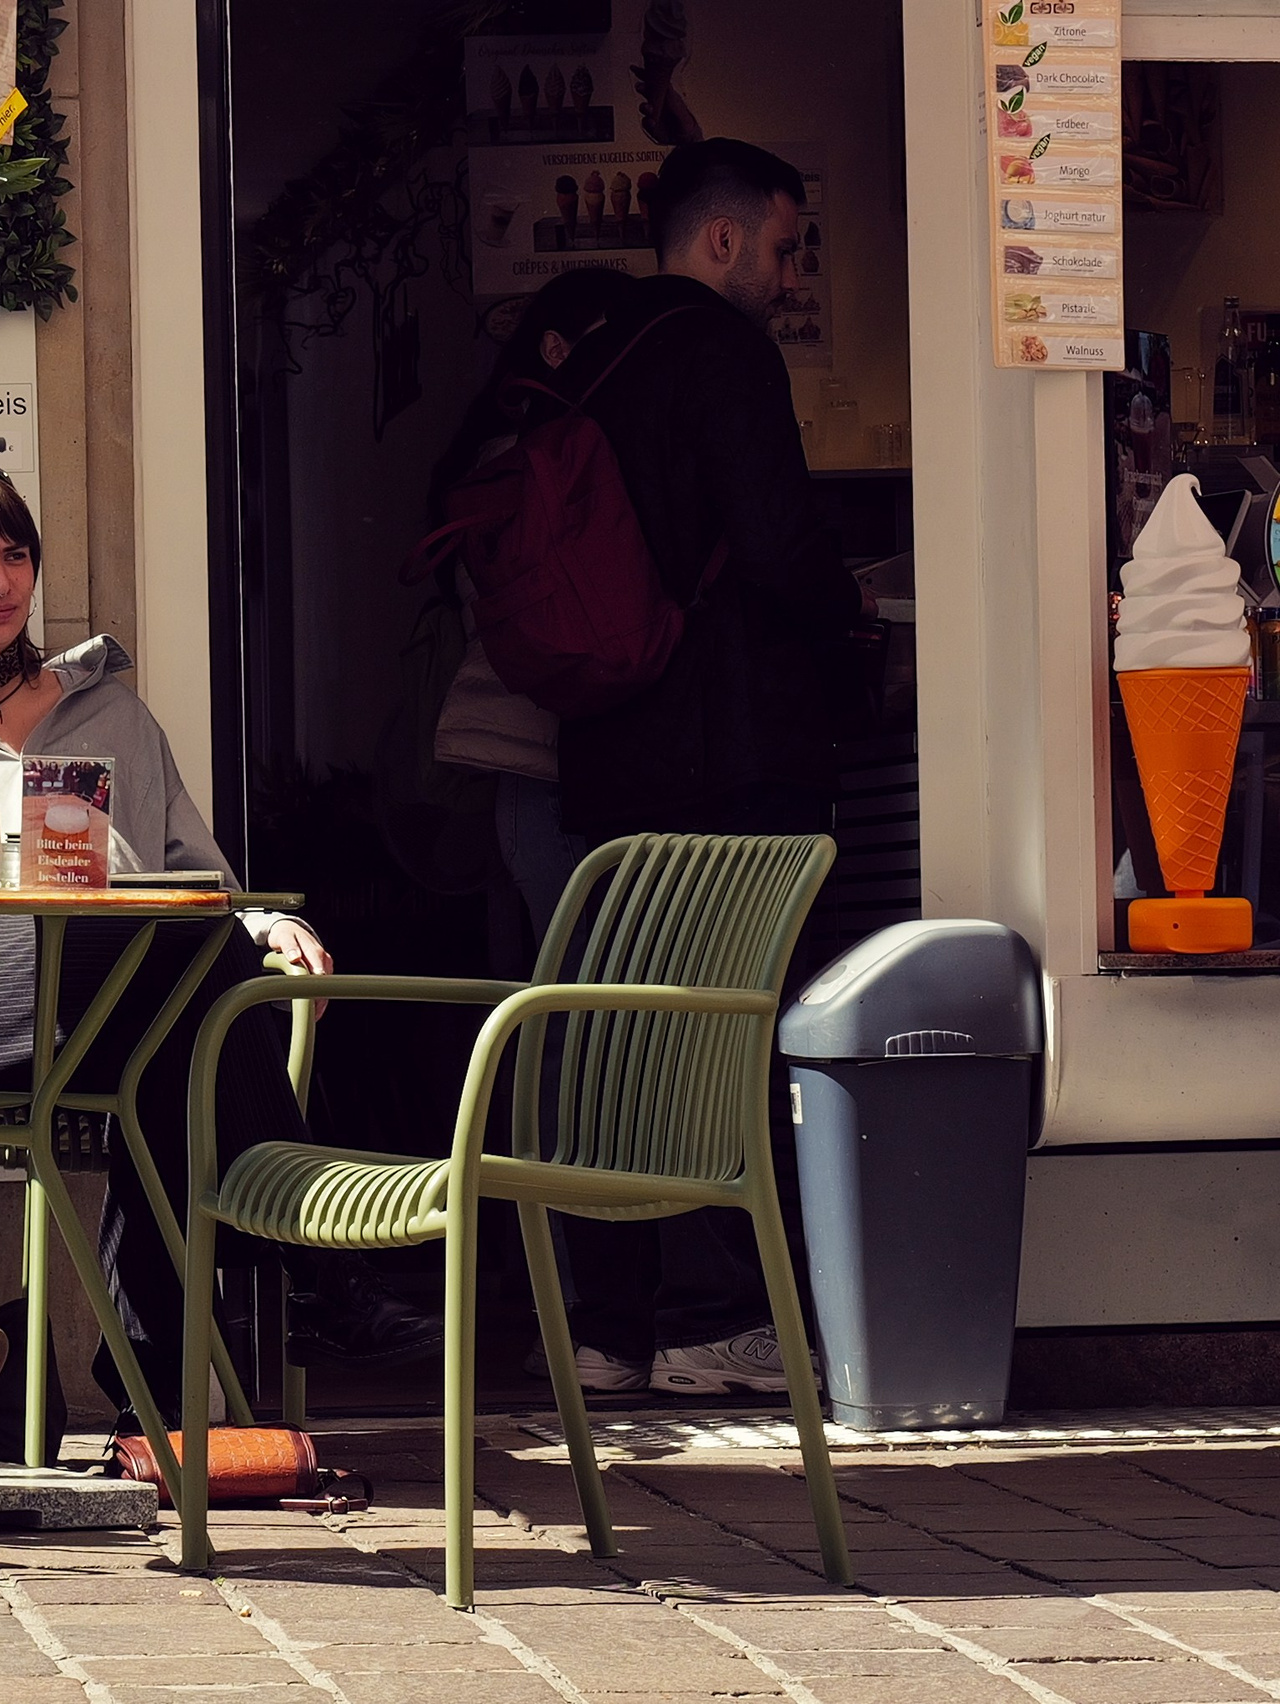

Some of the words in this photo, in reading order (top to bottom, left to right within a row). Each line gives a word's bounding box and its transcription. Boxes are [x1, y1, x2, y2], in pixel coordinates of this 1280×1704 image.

[1054, 27, 1087, 37] Zitrone
[1024, 45, 1045, 66] vegan
[1037, 73, 1058, 83] Dark
[1060, 73, 1105, 84] Chocolate
[1057, 119, 1090, 130] Erdbeer
[1030, 136, 1049, 159] vegan
[542, 153, 597, 165] VERSCHIEDENE
[600, 151, 634, 163] KUGELEIS
[637, 151, 666, 162] SORTEN
[1060, 166, 1090, 178] Mango
[1044, 210, 1079, 223] Joghurt
[1082, 213, 1106, 222] natur
[512, 258, 549, 276] CRÊPES
[551, 260, 559, 275] &
[1052, 256, 1102, 268] Schokolade
[1061, 303, 1096, 314] Pistazie
[1066, 345, 1104, 356] Walnuss
[36, 838, 63, 850] Bitte
[64, 838, 93, 851] beim
[37, 855, 91, 867] Eisdealer
[38, 871, 89, 883] bestellen
[743, 1337, 777, 1361] N
